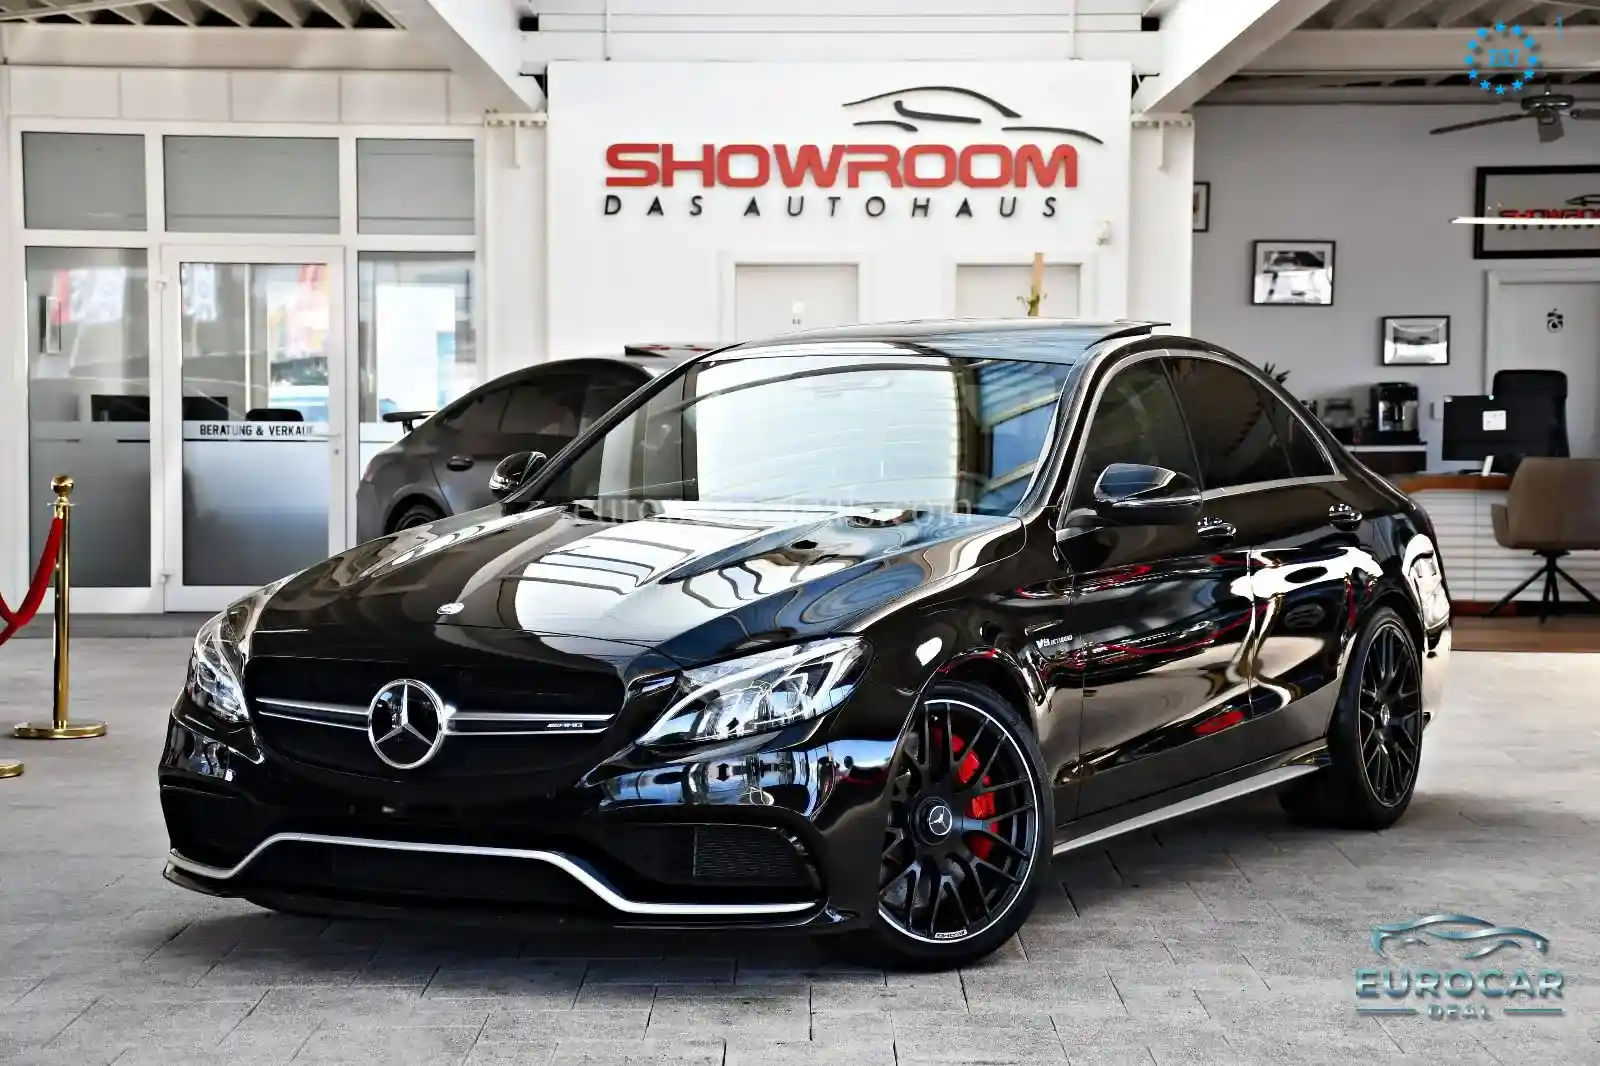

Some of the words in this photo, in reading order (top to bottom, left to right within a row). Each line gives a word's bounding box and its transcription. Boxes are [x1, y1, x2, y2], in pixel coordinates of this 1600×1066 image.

[605, 143, 1079, 188] SHOWROOM
[603, 195, 704, 217] DAS
[744, 195, 1058, 219] AUTOHAUS
[200, 424, 253, 436] BERATUNG
[256, 425, 264, 436] &
